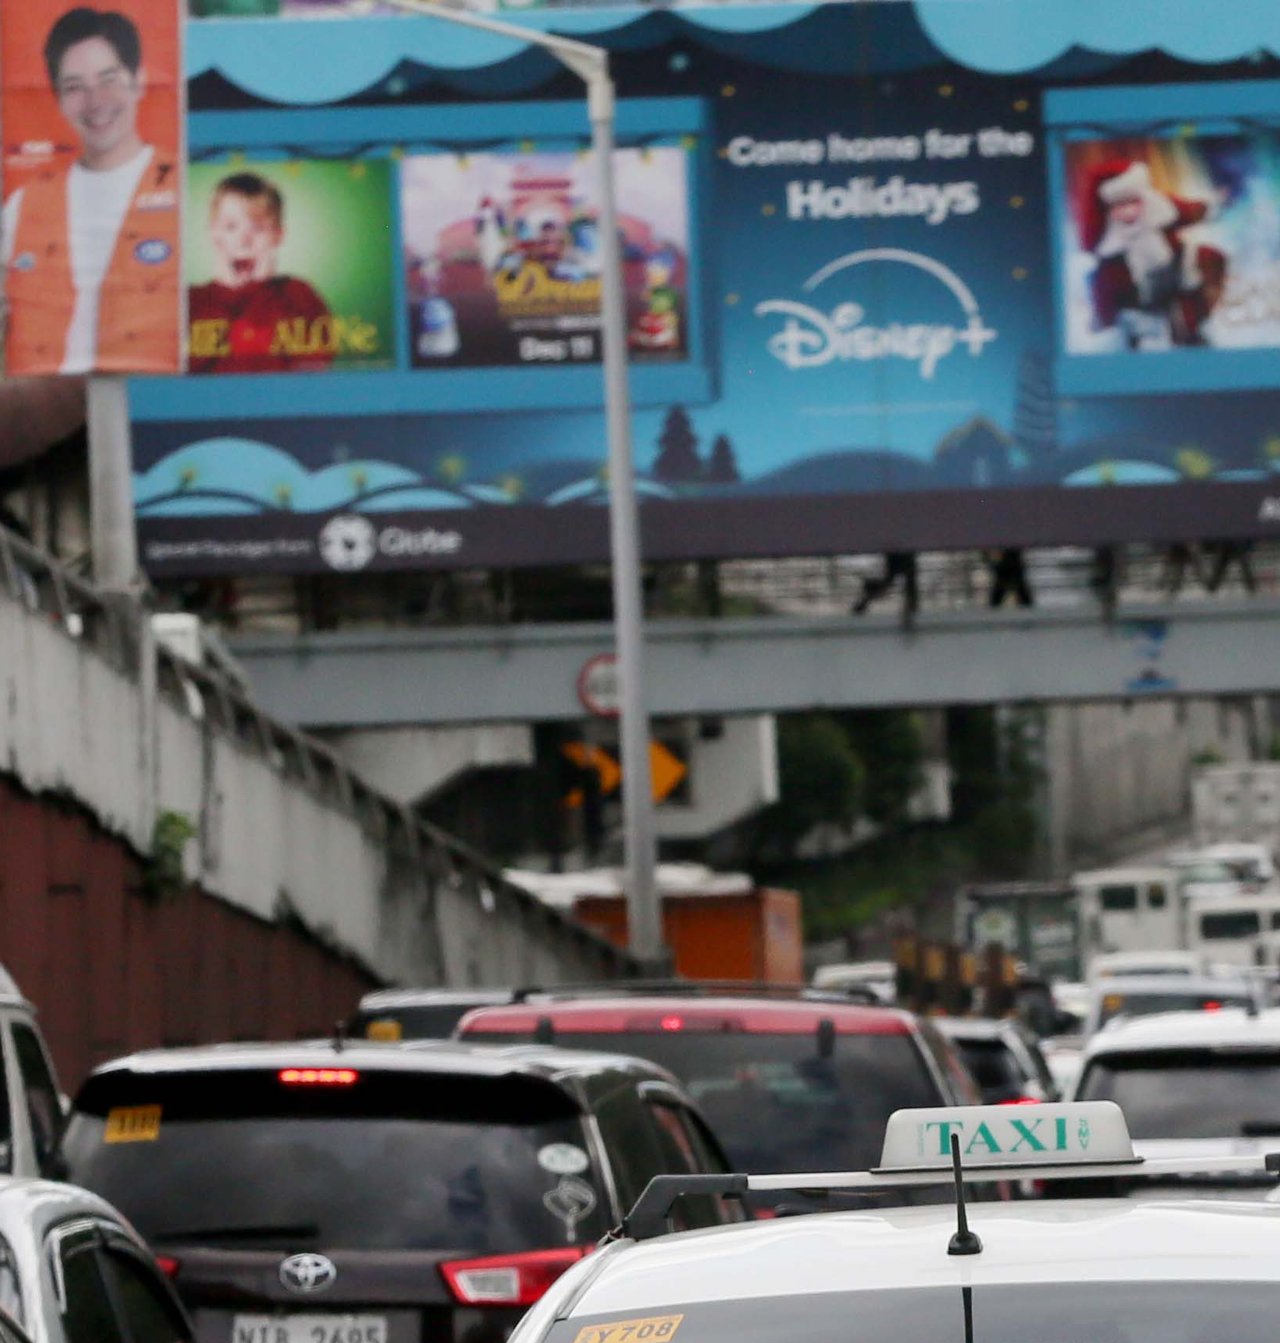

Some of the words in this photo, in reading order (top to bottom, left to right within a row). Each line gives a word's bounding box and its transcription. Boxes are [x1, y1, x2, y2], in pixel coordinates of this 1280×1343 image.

[727, 136, 825, 167] Come
[828, 132, 919, 162] home
[924, 128, 970, 158] for
[977, 126, 1033, 157] the
[786, 176, 981, 225] Holidays
[926, 1117, 1067, 1156] TAXI
[618, 1321, 674, 1342] 708
